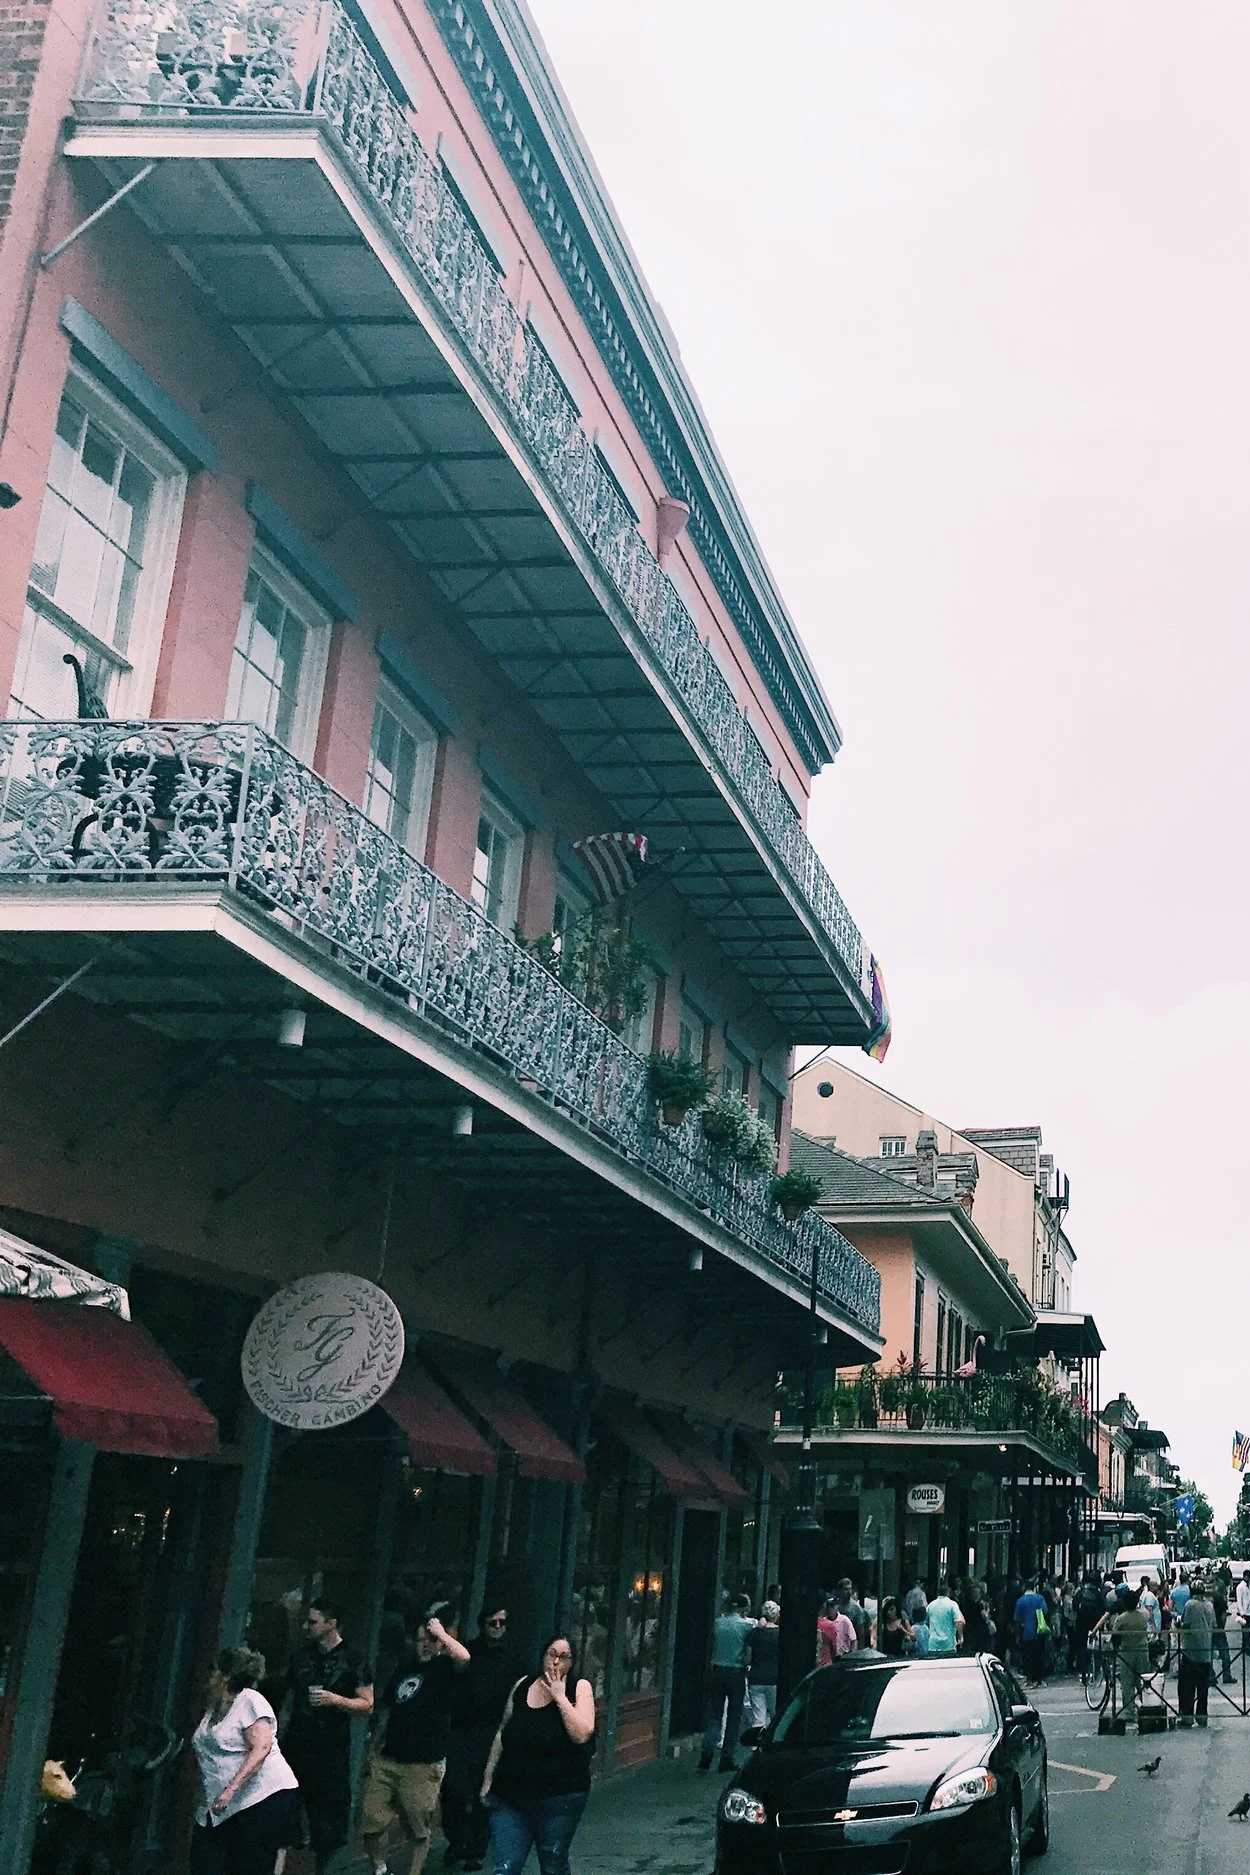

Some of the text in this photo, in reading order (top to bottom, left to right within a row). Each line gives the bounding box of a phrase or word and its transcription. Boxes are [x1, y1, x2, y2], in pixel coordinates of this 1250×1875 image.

[250, 1380, 381, 1426] FISCHER GAMBINO
[911, 1489, 938, 1500] ROUSES
